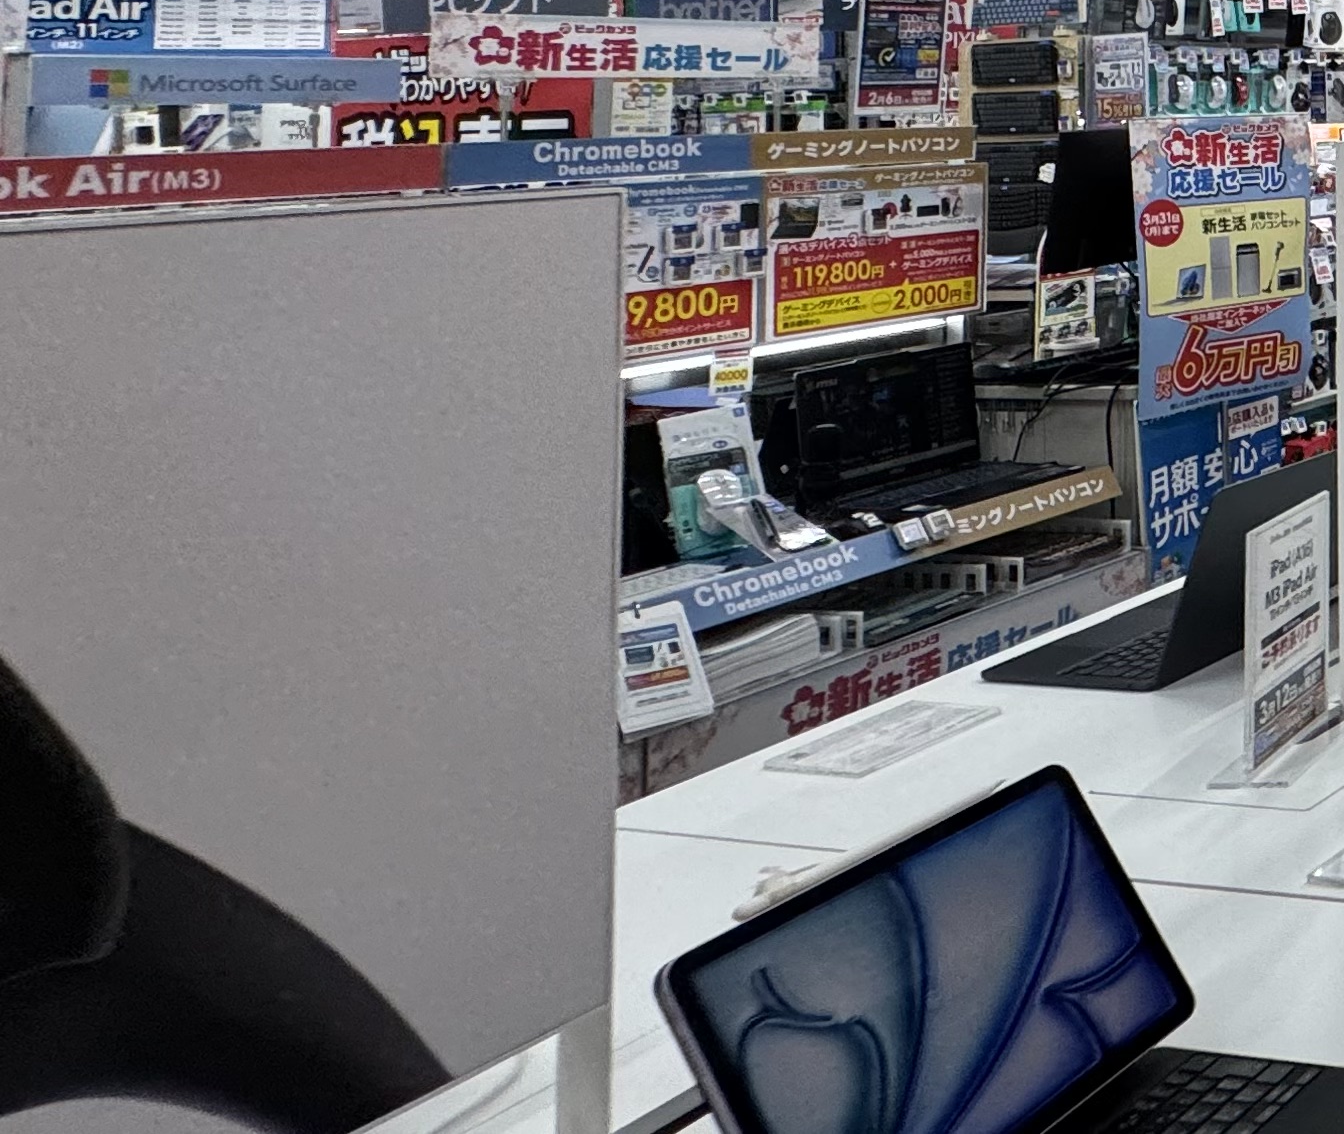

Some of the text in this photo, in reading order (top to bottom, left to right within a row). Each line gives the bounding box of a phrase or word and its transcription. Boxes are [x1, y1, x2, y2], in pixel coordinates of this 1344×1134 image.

[516, 29, 789, 72] 新生活 応援セール
[139, 73, 357, 94] Microsoft Surface
[533, 140, 702, 164] Chromebook
[768, 137, 960, 160] ゲーミングノートパソコン
[1195, 132, 1282, 167] 新生活
[558, 159, 679, 177] Detachable CM3
[1169, 168, 1285, 195] 応援セール
[1142, 212, 1181, 226] 3月31日
[1202, 216, 1247, 234] 新生活
[793, 260, 884, 288] 119,800円
[893, 282, 962, 311] 2,000円
[693, 544, 859, 609] Chromebook
[812, 569, 844, 592] CM3
